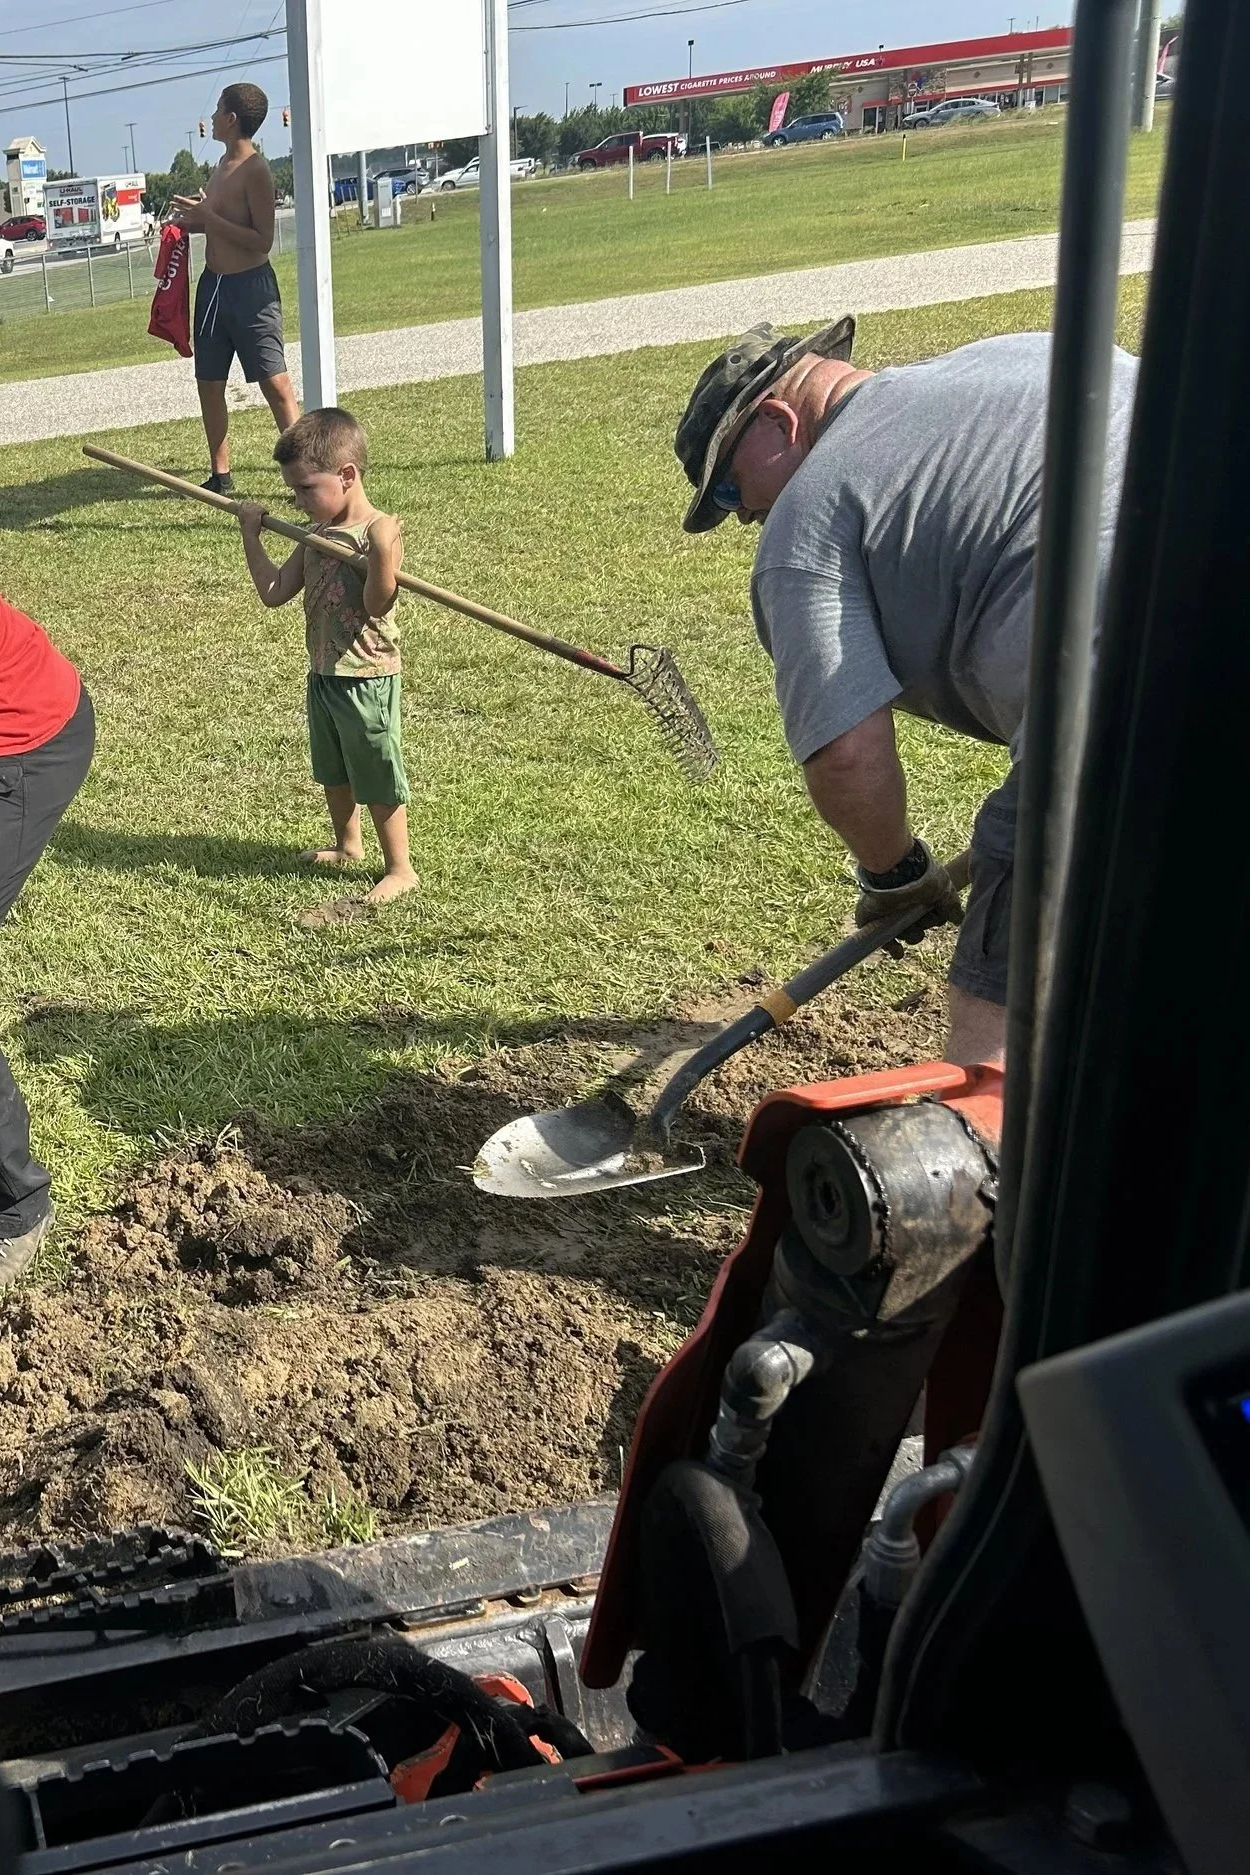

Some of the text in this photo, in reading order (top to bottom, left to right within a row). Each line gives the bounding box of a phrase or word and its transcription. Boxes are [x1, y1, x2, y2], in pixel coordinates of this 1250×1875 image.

[855, 58, 876, 68] USA
[638, 83, 679, 97] LOWEST
[680, 79, 717, 90] CIGARETTE
[719, 75, 743, 85] PRICES
[49, 196, 95, 208] SELF-STORAGE
